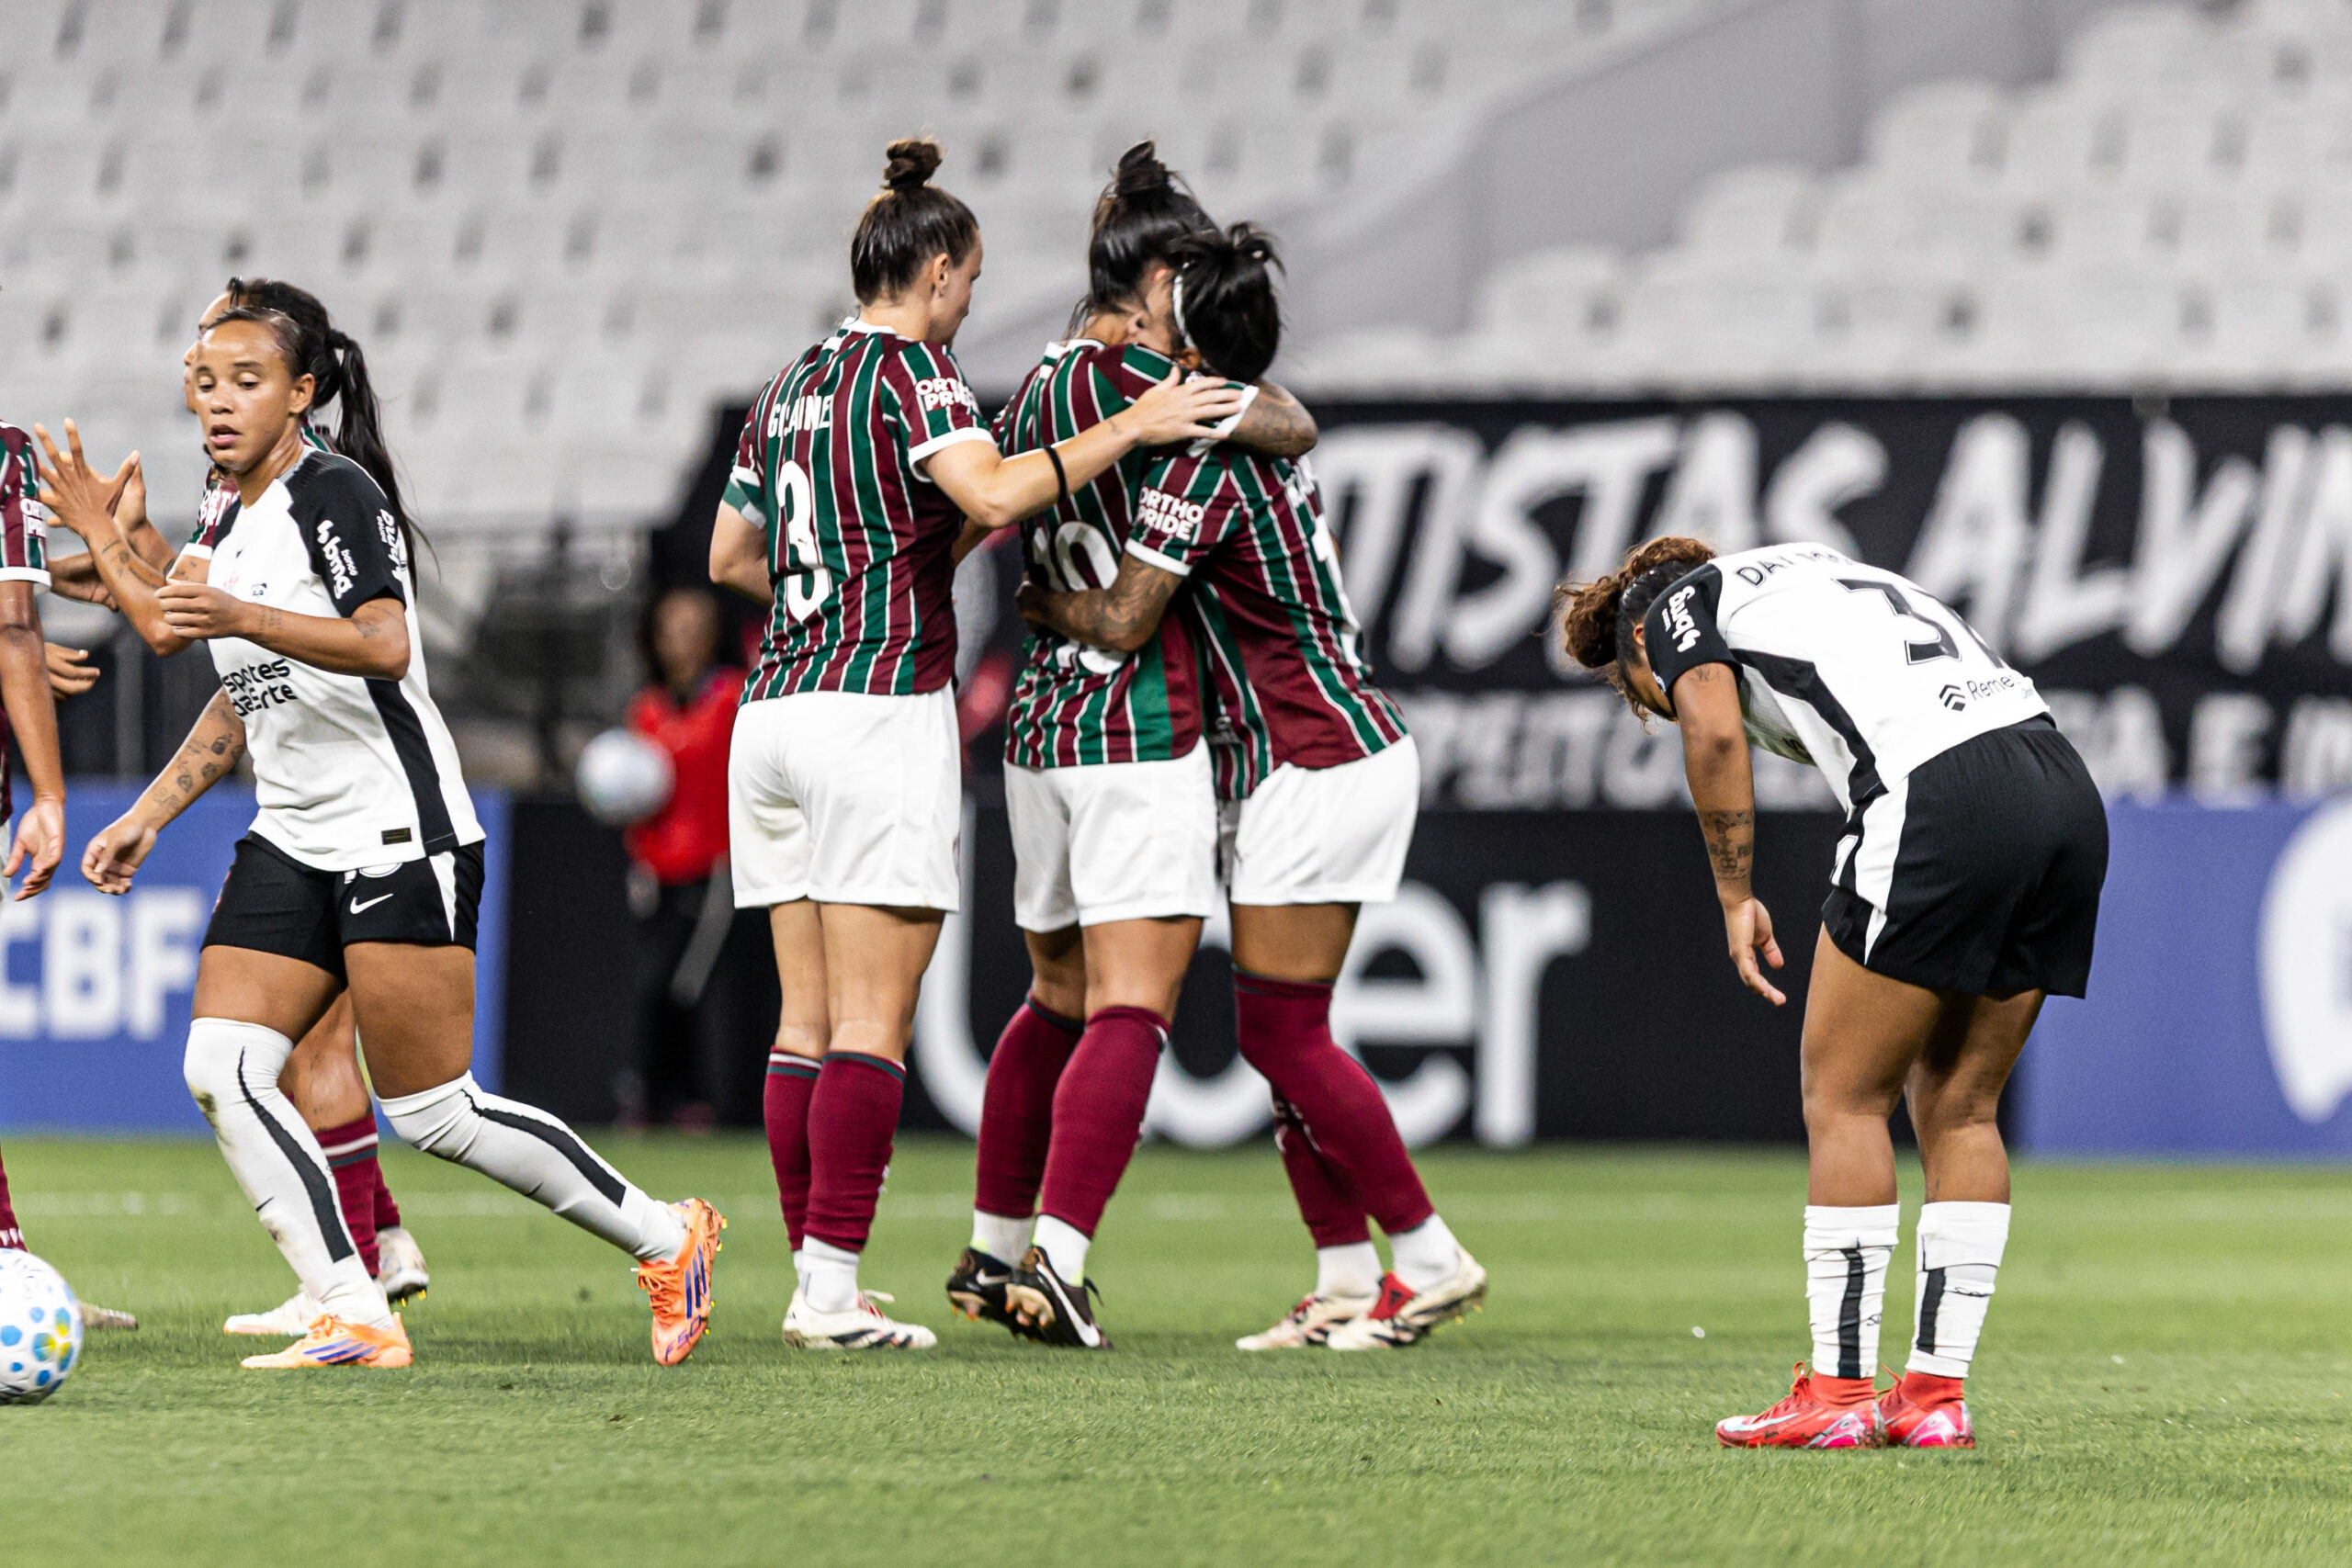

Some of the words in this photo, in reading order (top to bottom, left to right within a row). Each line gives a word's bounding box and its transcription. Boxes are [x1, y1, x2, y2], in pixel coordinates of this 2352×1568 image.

[1136, 505, 1194, 541] PRIDE
[1139, 487, 1205, 525] ORTHO
[322, 536, 355, 600] bmg
[777, 459, 832, 625] 3
[1668, 585, 1696, 640] bmg
[0, 886, 206, 1041] CBF
